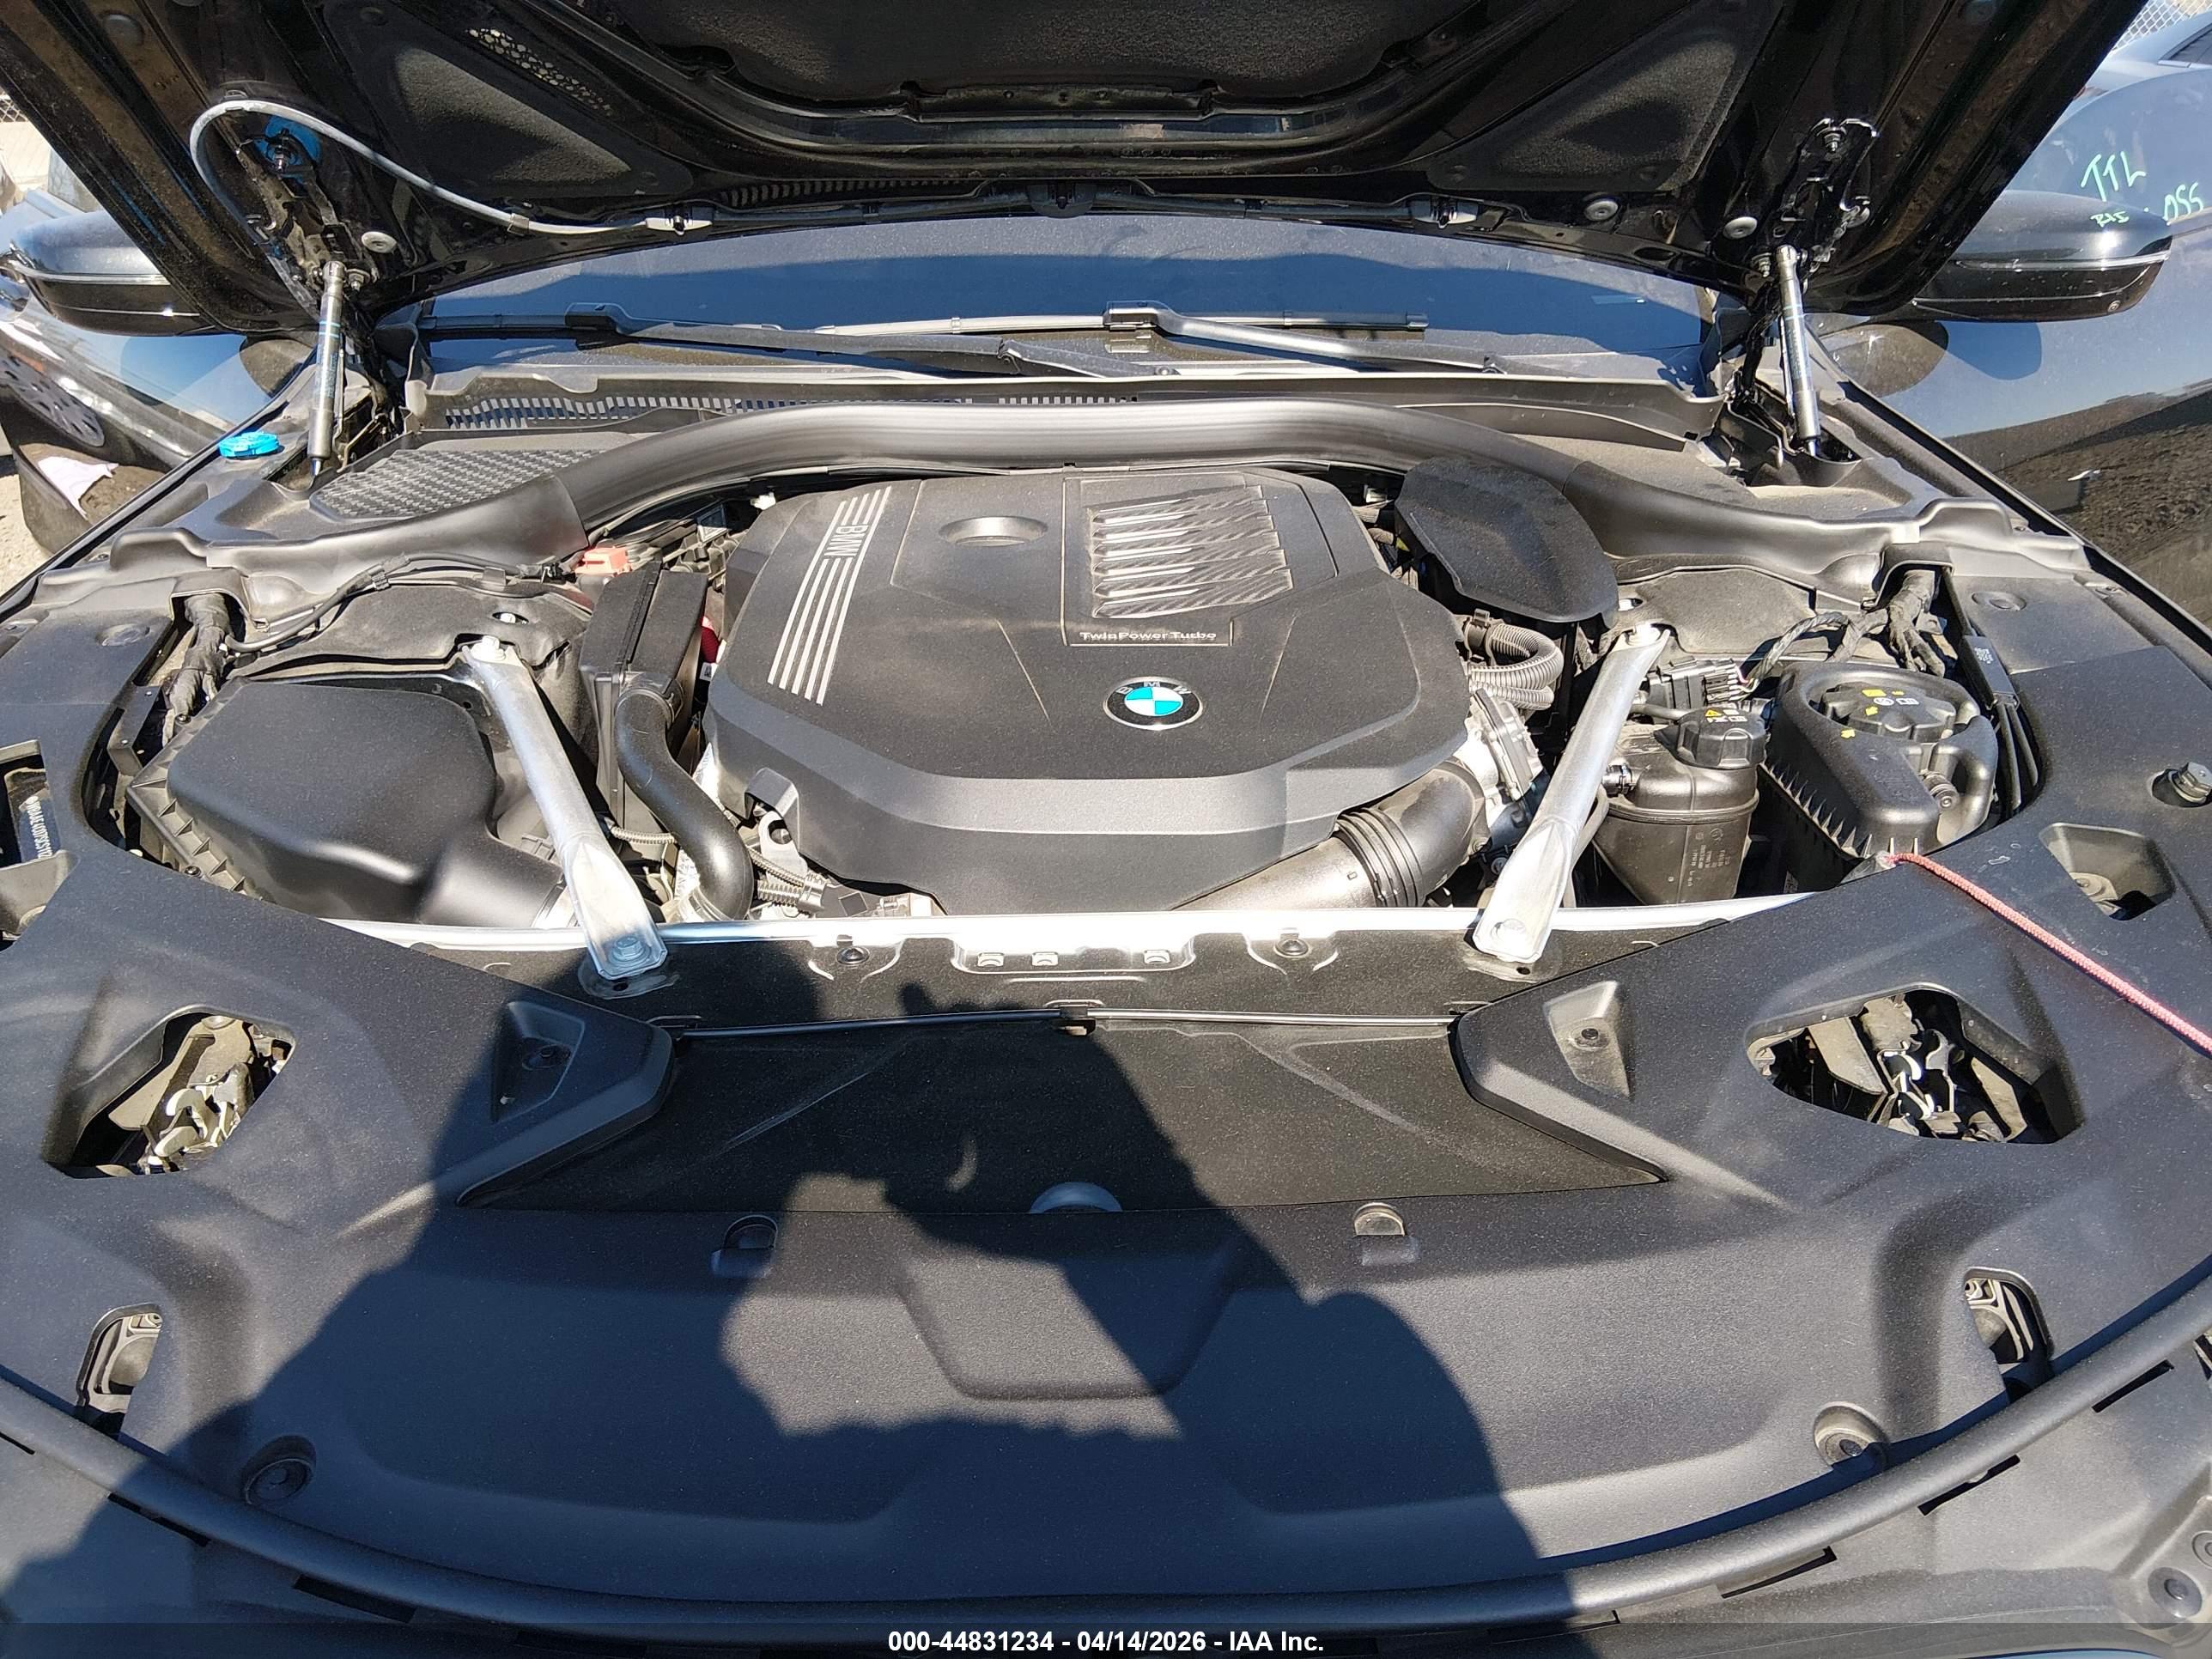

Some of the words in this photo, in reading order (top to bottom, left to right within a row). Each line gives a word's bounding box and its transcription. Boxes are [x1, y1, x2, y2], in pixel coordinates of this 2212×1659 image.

[823, 525, 869, 556] BMW
[1170, 631, 1217, 640] Turbo
[1115, 680, 1192, 695] BMW
